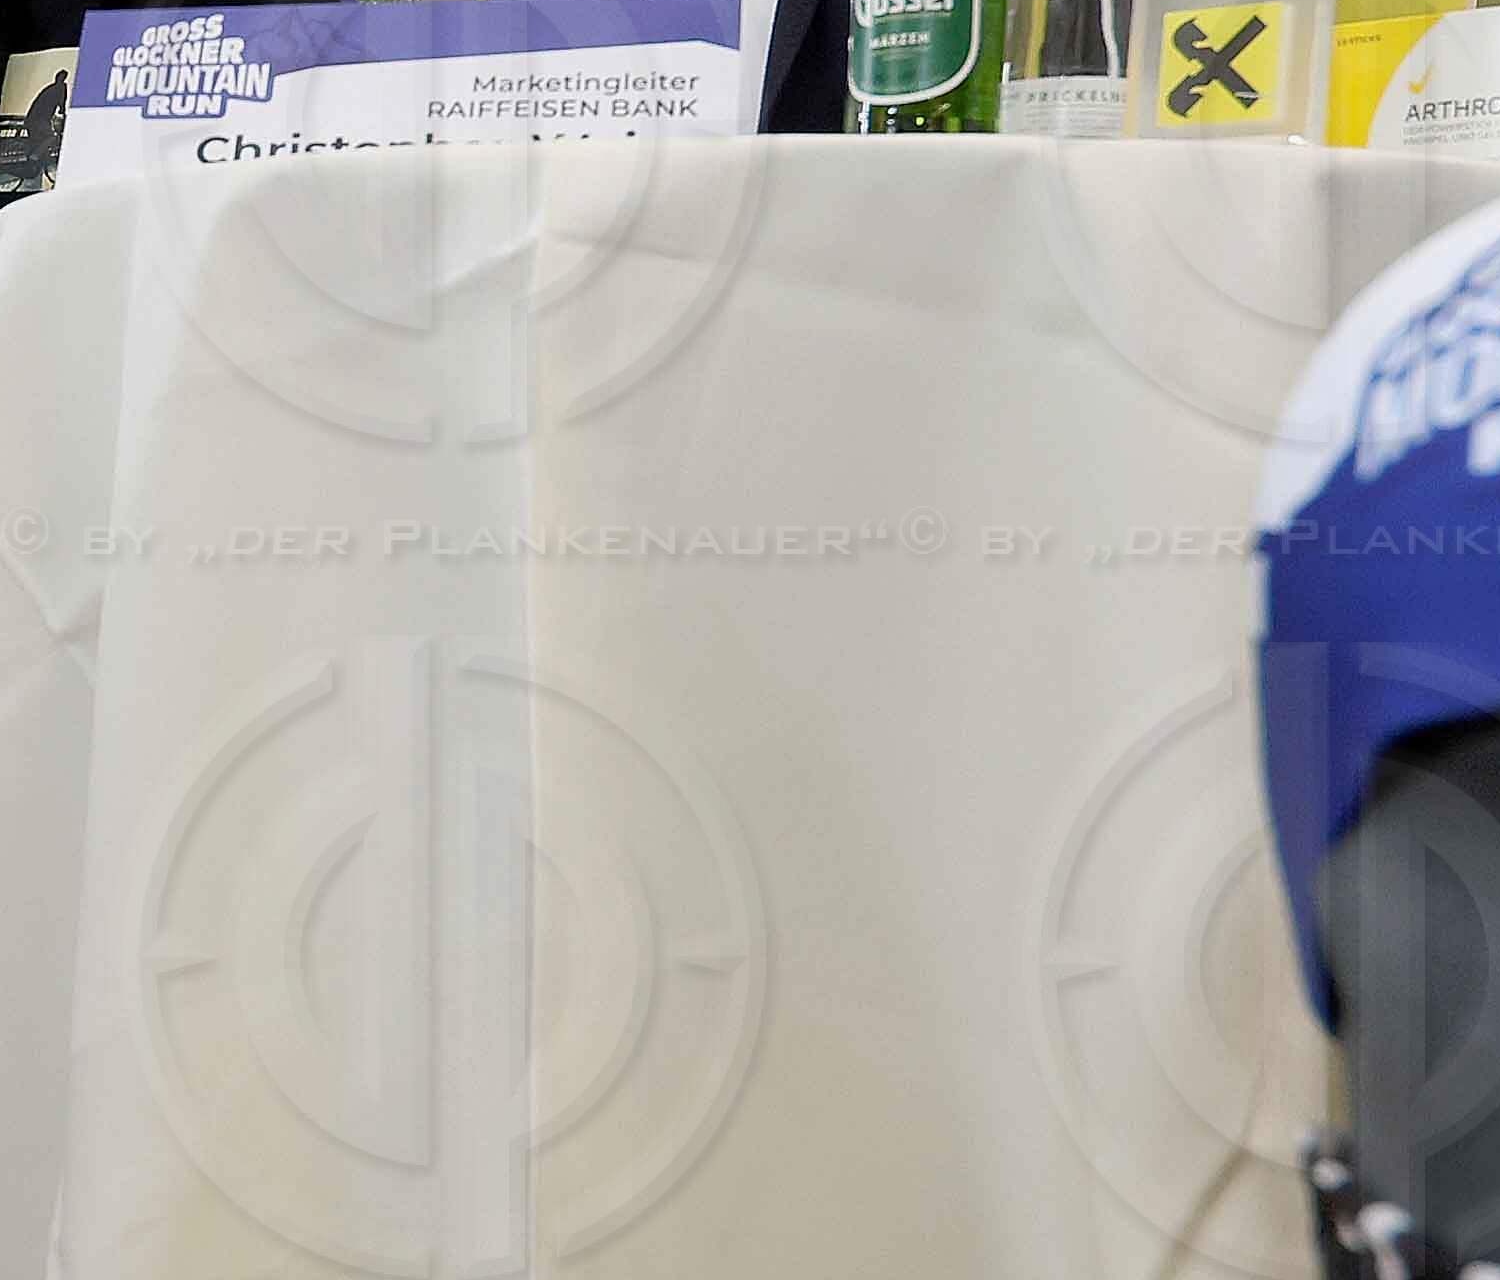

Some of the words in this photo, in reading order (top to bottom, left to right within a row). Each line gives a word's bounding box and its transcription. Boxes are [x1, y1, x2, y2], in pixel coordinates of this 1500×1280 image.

[143, 13, 224, 46] GROSS
[112, 37, 245, 67] GLOCKNER
[106, 62, 272, 101] MOUNTAIN
[472, 74, 699, 97] Marketingleiter
[146, 94, 223, 115] RUN
[427, 100, 599, 119] RAIFFEISEN
[611, 99, 697, 118] BANK
